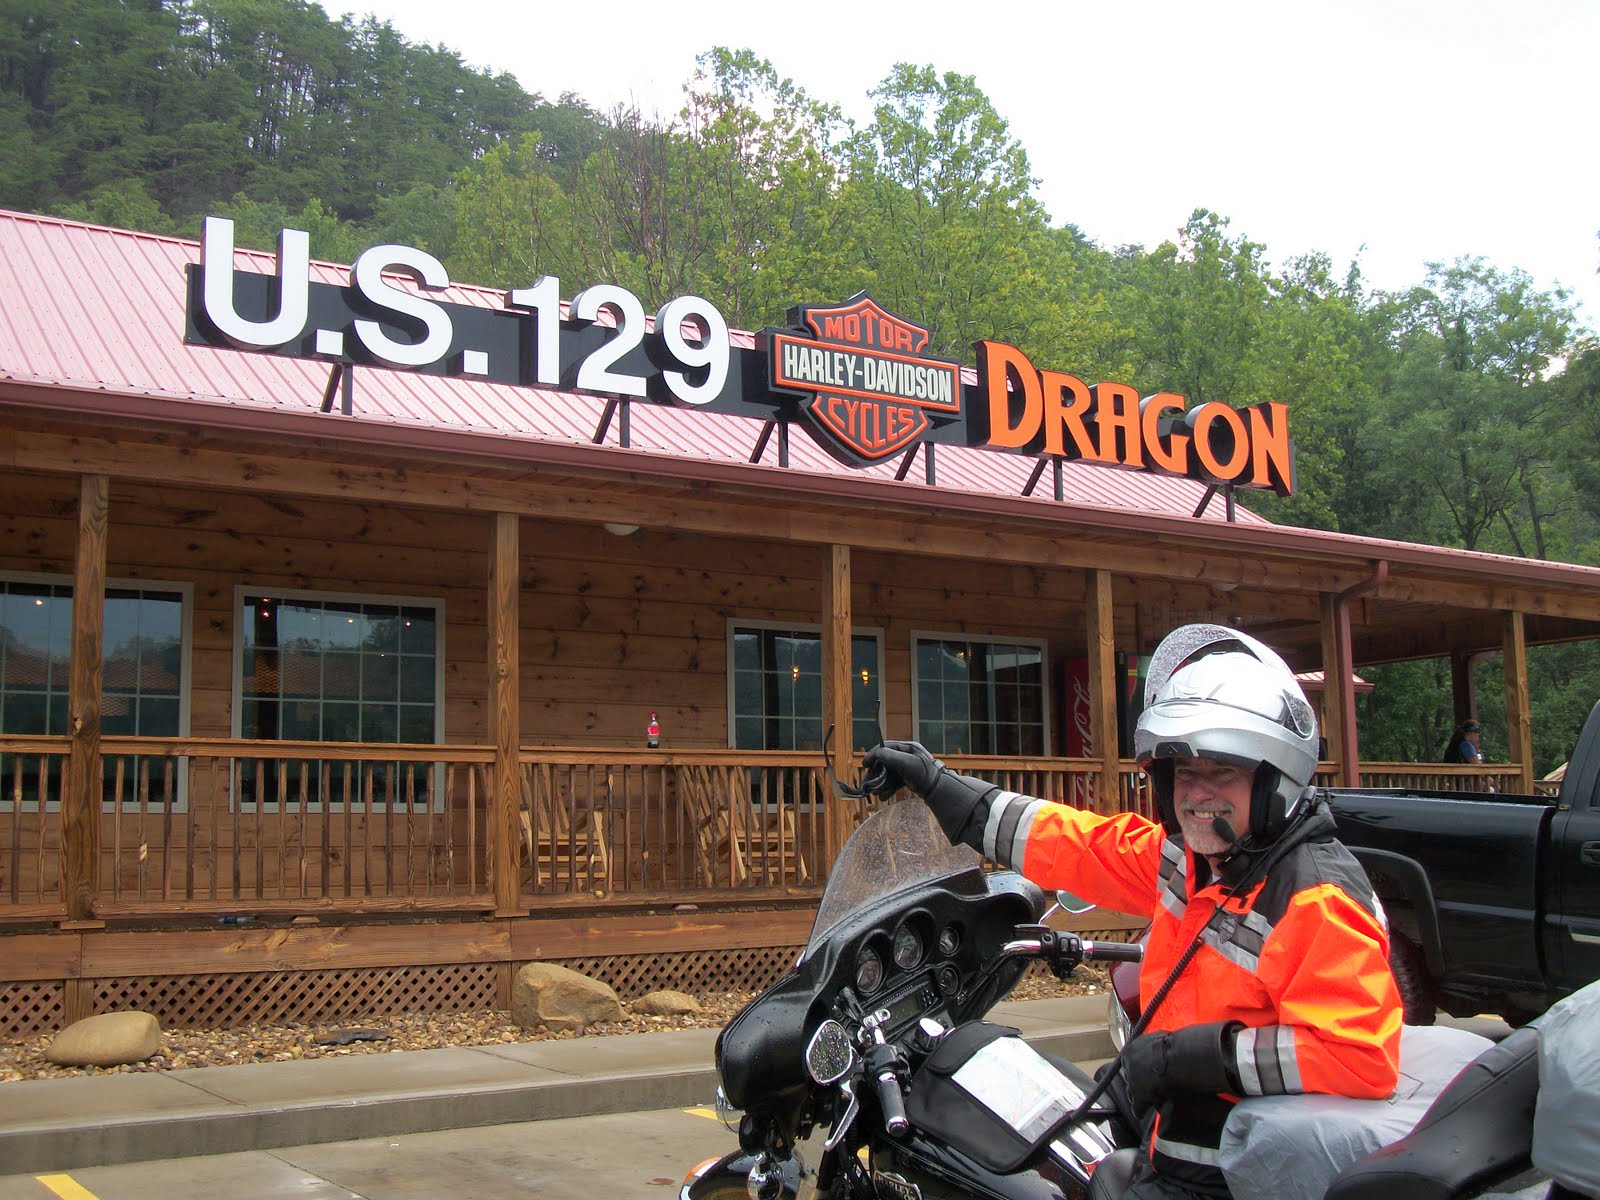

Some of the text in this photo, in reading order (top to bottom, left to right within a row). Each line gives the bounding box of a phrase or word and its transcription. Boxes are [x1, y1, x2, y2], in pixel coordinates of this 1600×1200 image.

[825, 308, 913, 352] MOTOR
[784, 344, 952, 403] HARLEY-DAVIDSON
[828, 397, 914, 449] CYCLES
[978, 339, 1294, 496] DRAGON
